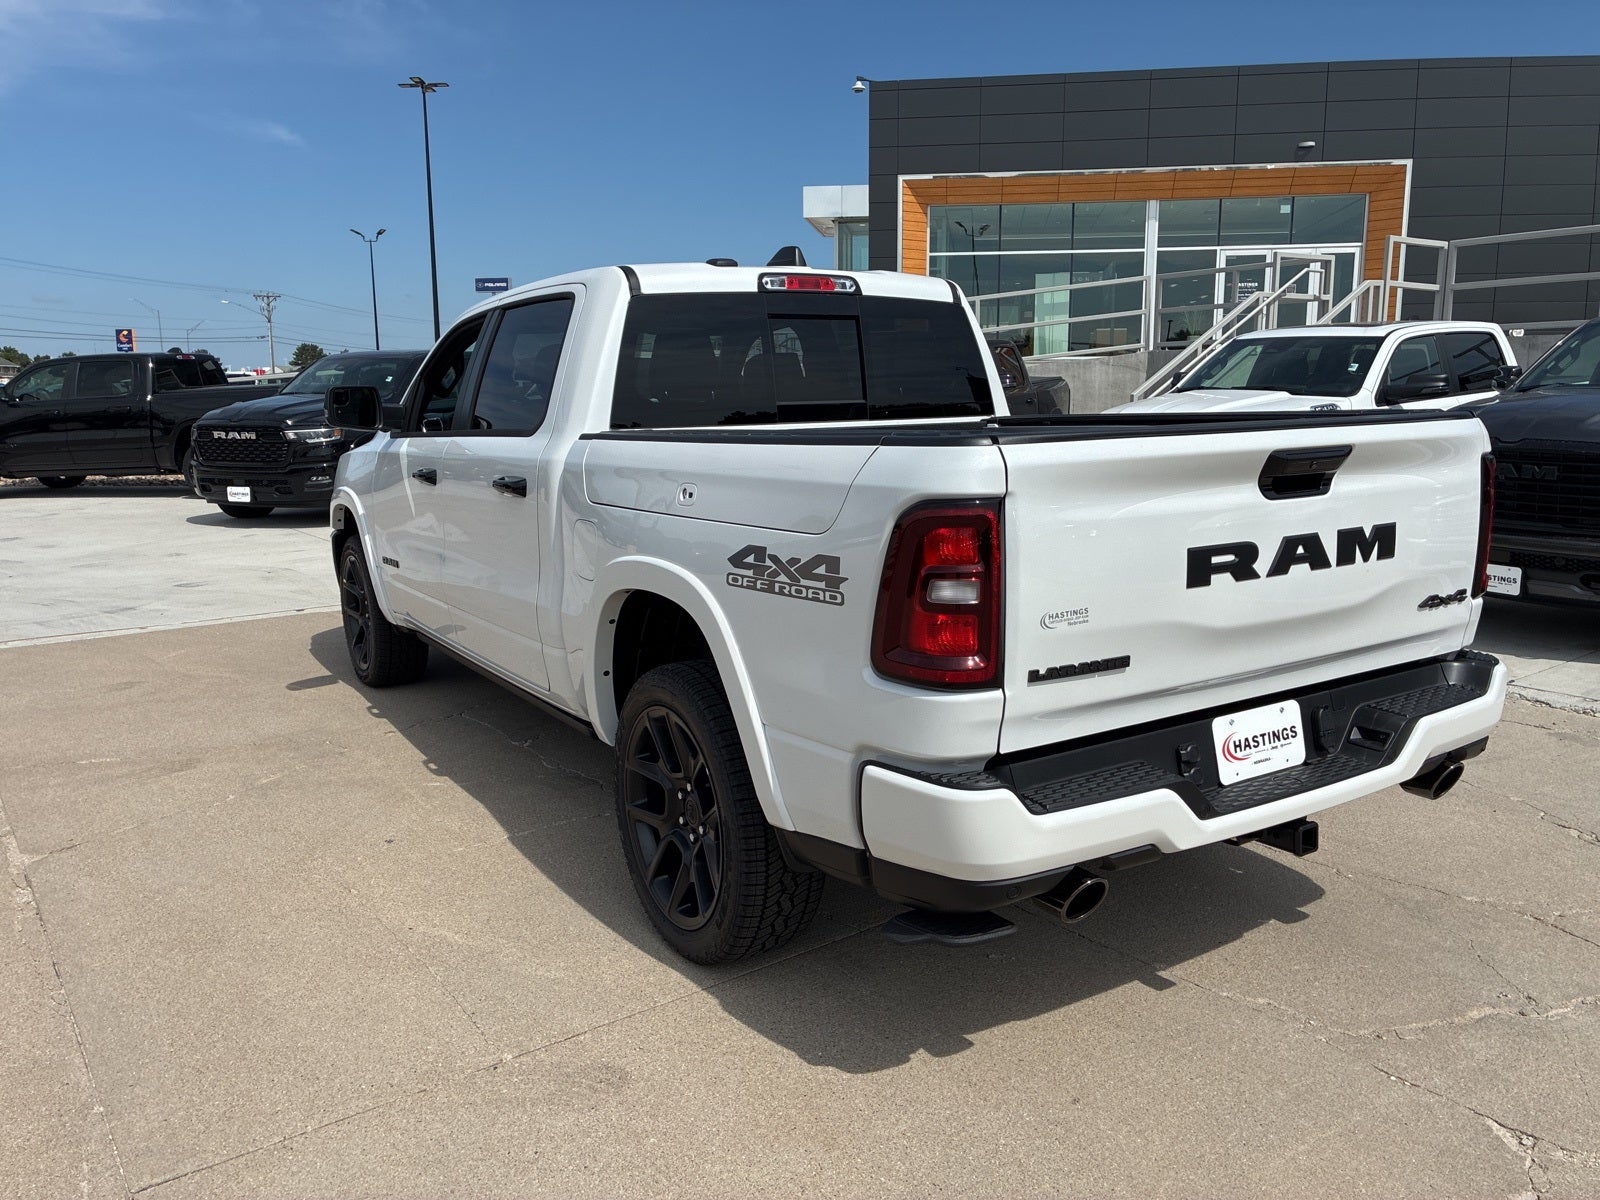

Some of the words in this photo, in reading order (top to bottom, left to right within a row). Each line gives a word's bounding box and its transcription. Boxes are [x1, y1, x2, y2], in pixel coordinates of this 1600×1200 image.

[212, 430, 257, 440] RAM
[1496, 462, 1558, 481] AM
[1186, 521, 1397, 590] RAM
[728, 574, 769, 590] OFF
[774, 583, 842, 603] ROAD
[1488, 575, 1518, 585] STINGS
[1048, 607, 1089, 621] HASTINGS
[1027, 654, 1131, 683] LARAMIE
[1233, 725, 1298, 754] HASTINGS
